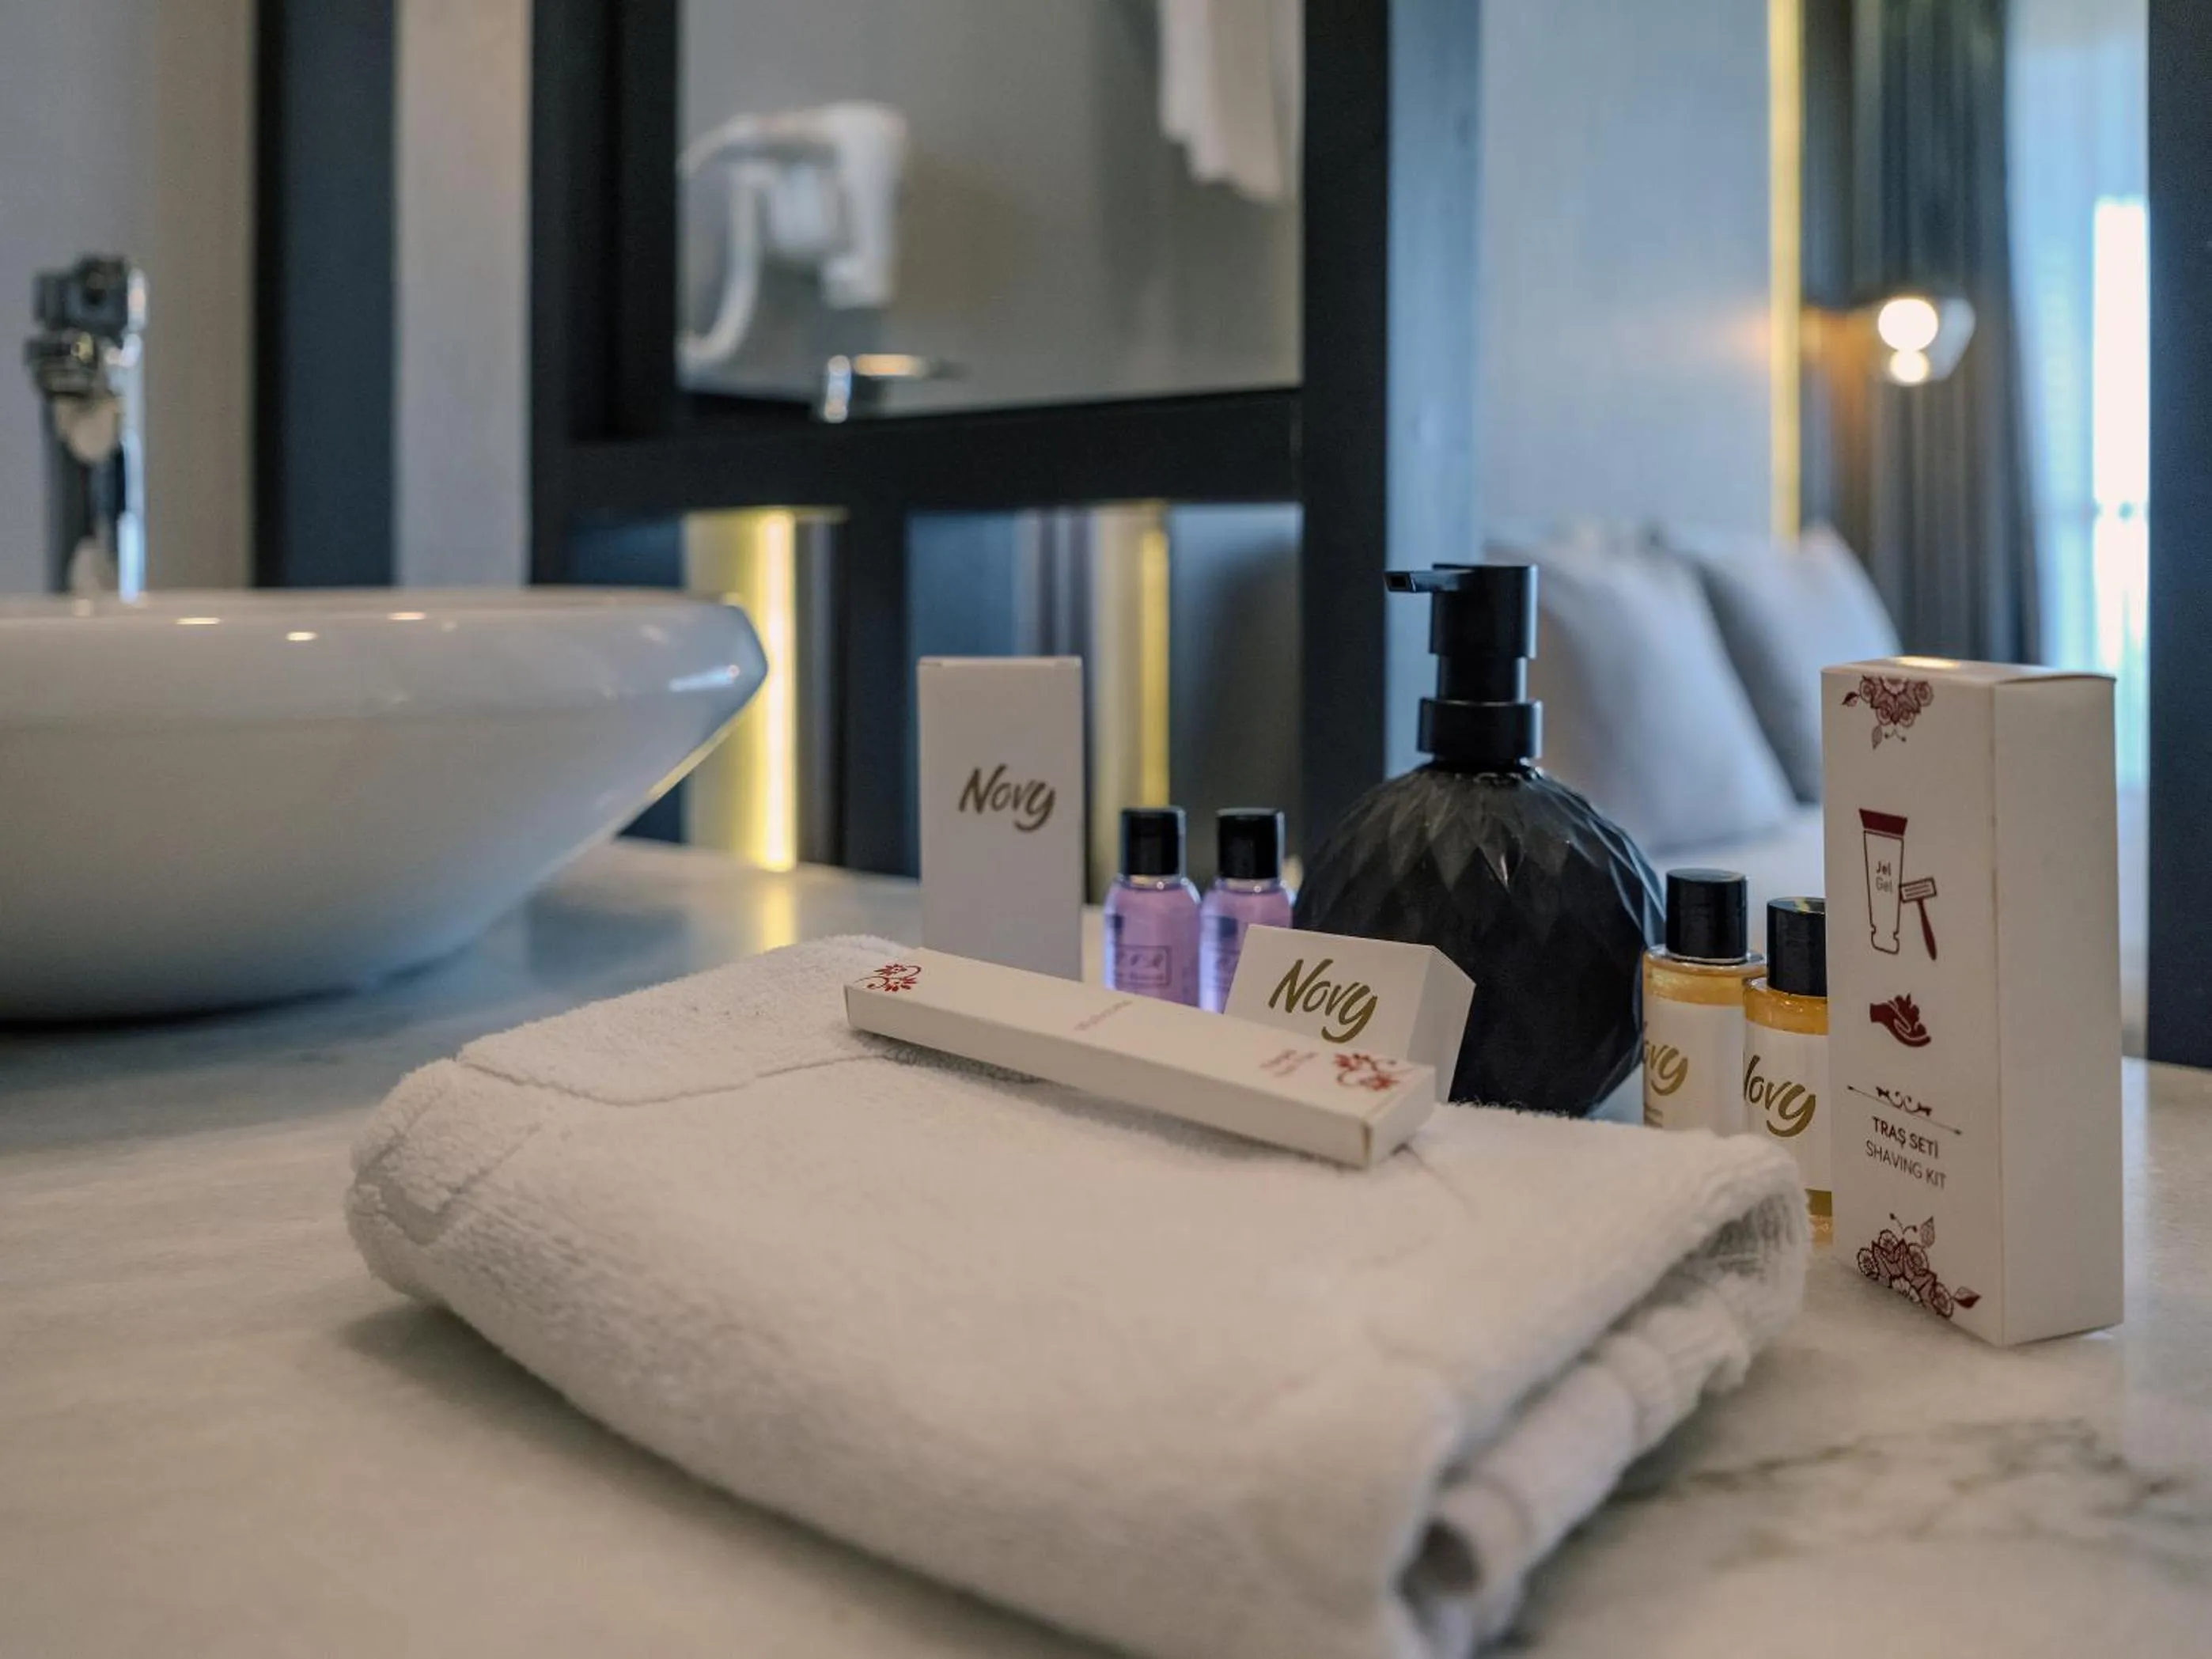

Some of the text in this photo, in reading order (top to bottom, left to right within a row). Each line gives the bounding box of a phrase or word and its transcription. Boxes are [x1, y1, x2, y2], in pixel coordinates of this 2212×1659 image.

[957, 763, 1055, 832] Novy
[1268, 958, 1378, 1044] Novy
[1872, 1115, 1906, 1150] TRAŞ
[1866, 1139, 1947, 1190] SHAVING KIT
